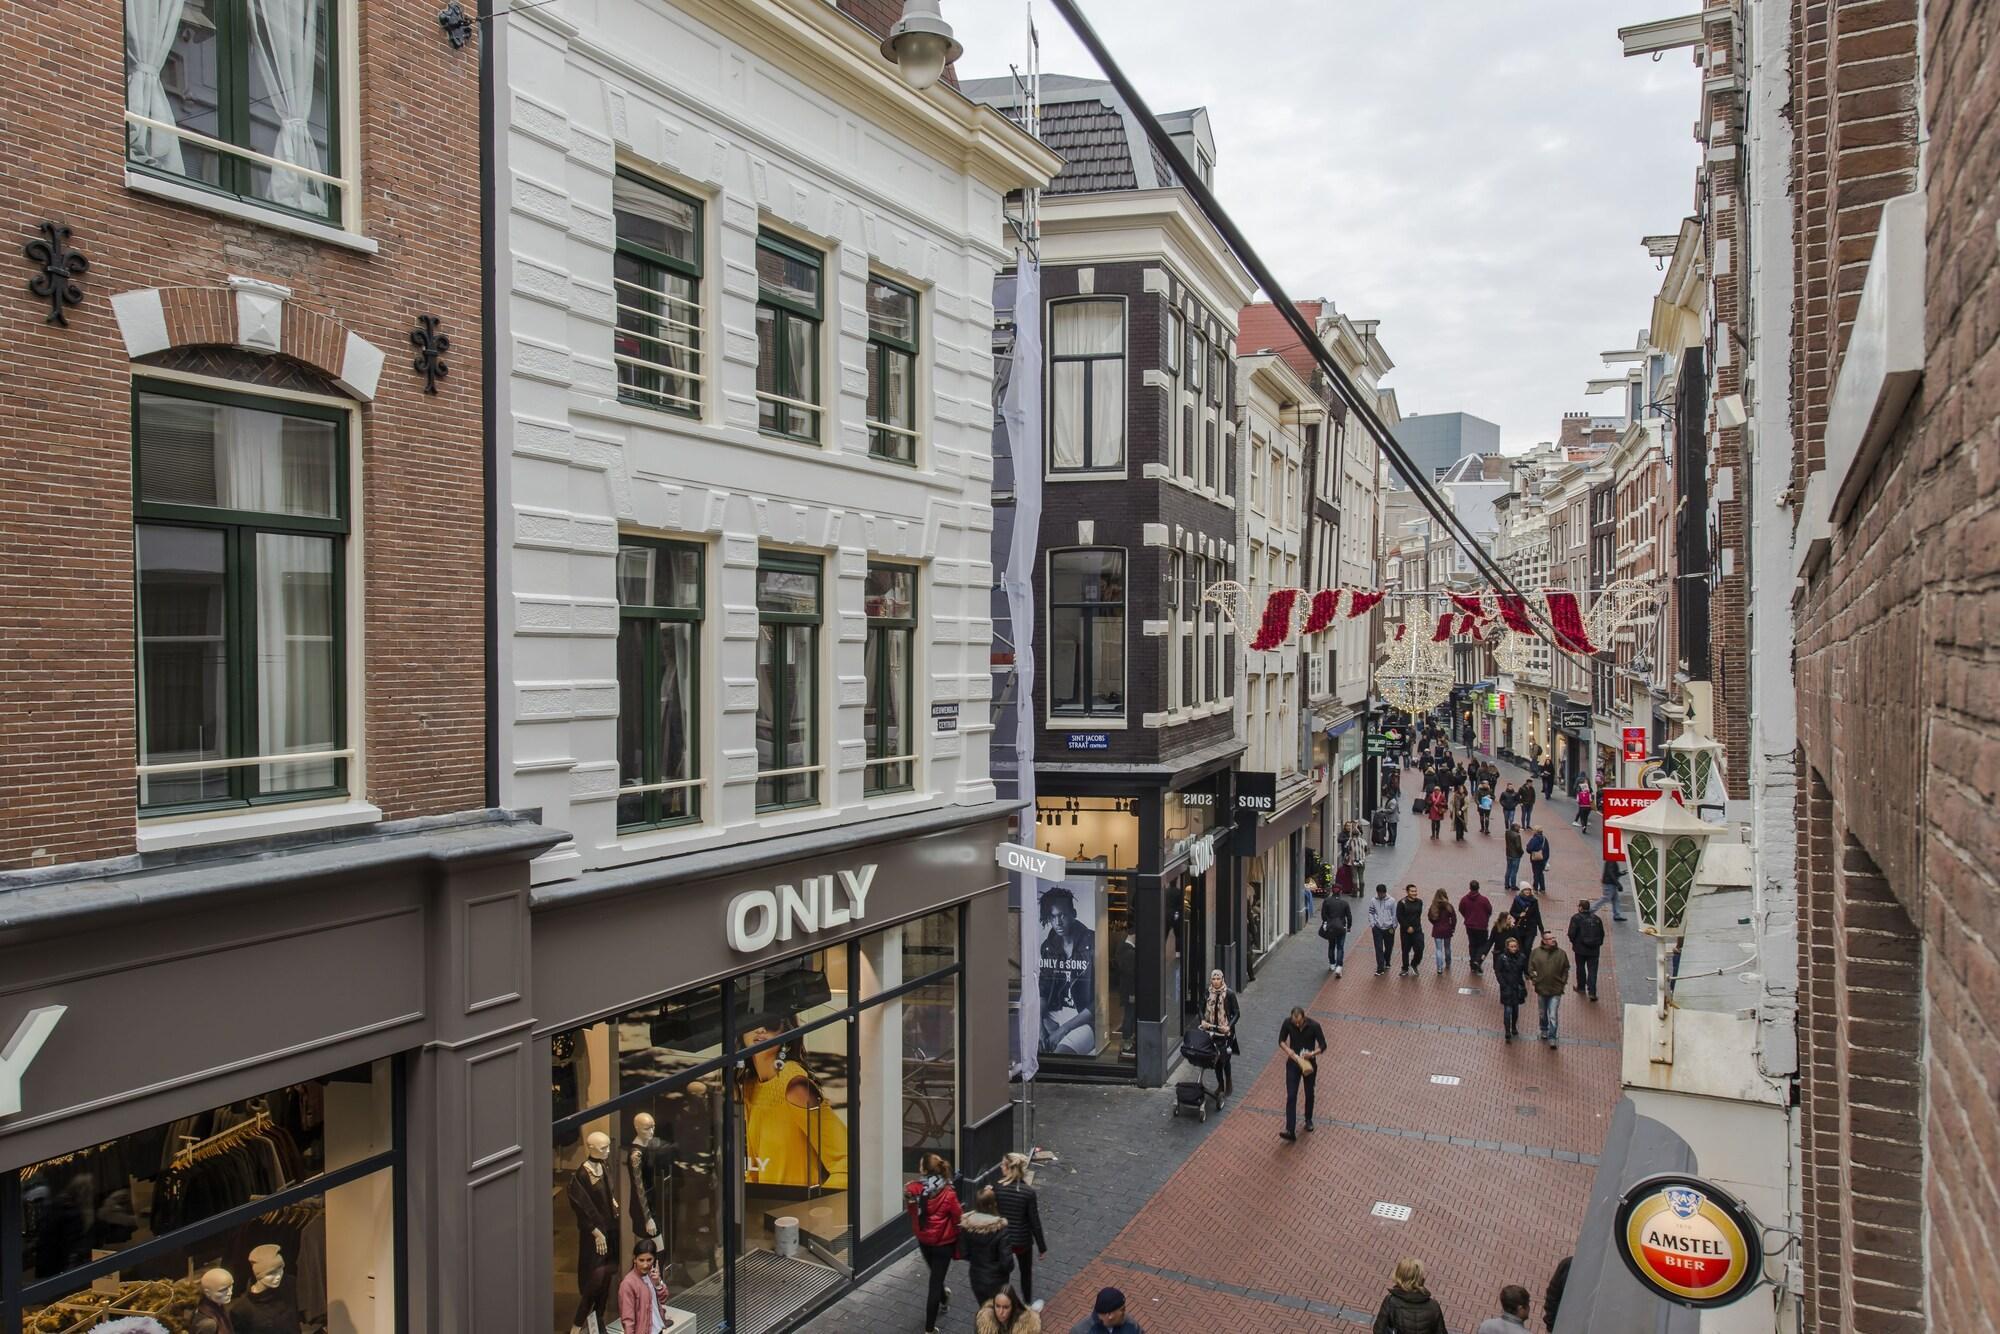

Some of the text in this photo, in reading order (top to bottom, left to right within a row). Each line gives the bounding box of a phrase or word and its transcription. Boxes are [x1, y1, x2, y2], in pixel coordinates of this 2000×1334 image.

[1238, 796, 1272, 809] SONS
[1607, 798, 1629, 807] TAX
[1008, 851, 1046, 873] ONLY
[726, 863, 878, 953] ONLY
[1039, 958, 1058, 969] ONLY
[1065, 959, 1088, 970] SONS
[1648, 1231, 1724, 1255] AMSTEL
[1664, 1255, 1705, 1271] BIER
